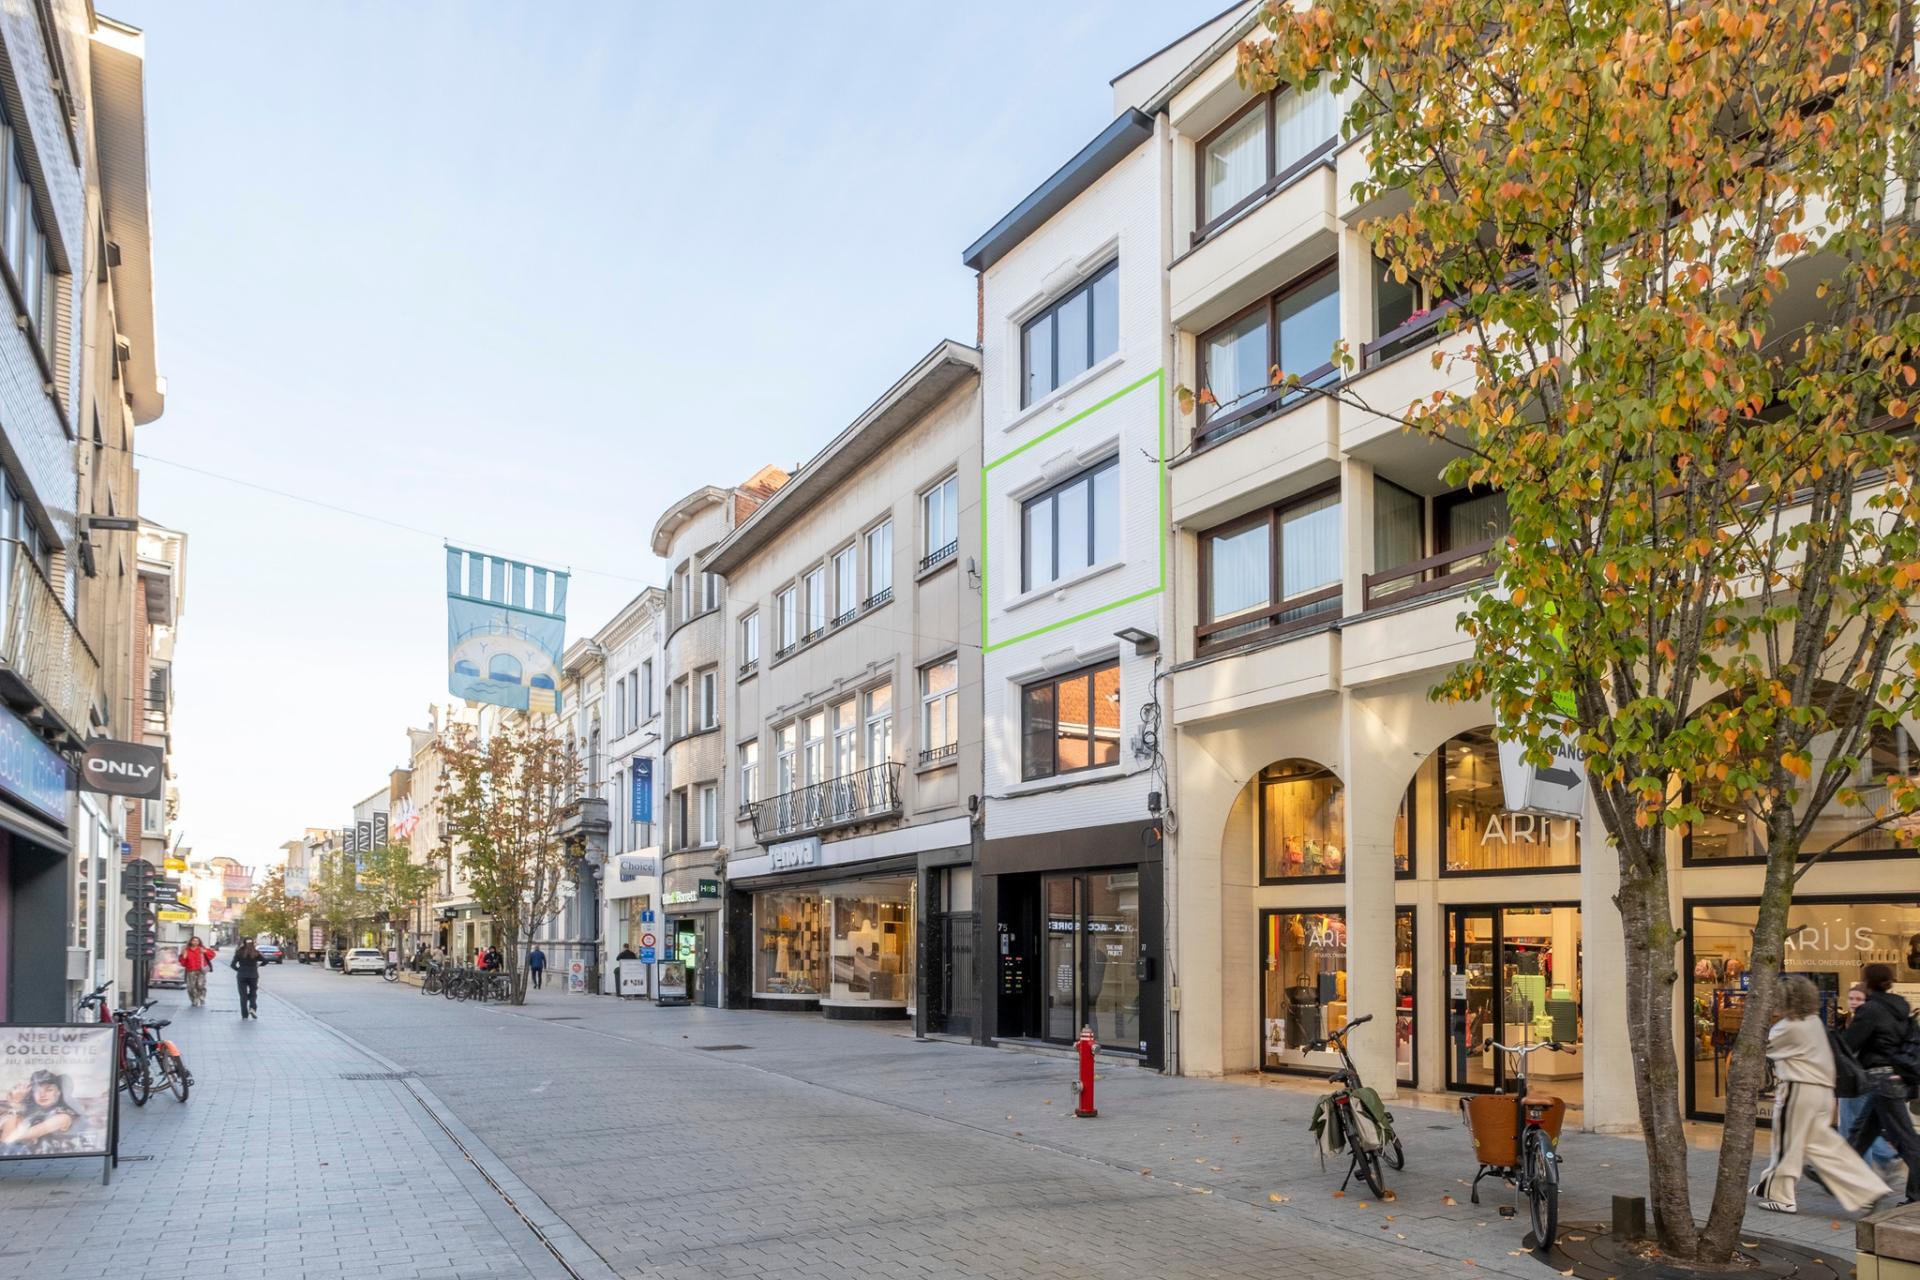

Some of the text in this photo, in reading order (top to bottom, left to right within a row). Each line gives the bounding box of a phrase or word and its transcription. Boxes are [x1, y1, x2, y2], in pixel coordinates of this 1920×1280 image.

[87, 757, 156, 778] ONLY
[1480, 812, 1582, 846] ARIJ
[620, 861, 653, 872] Choice
[997, 922, 1008, 932] 75
[1783, 926, 1875, 950] ARIJS
[18, 1032, 89, 1043] NIEUWE
[5, 1044, 97, 1055] COLLECTIE
